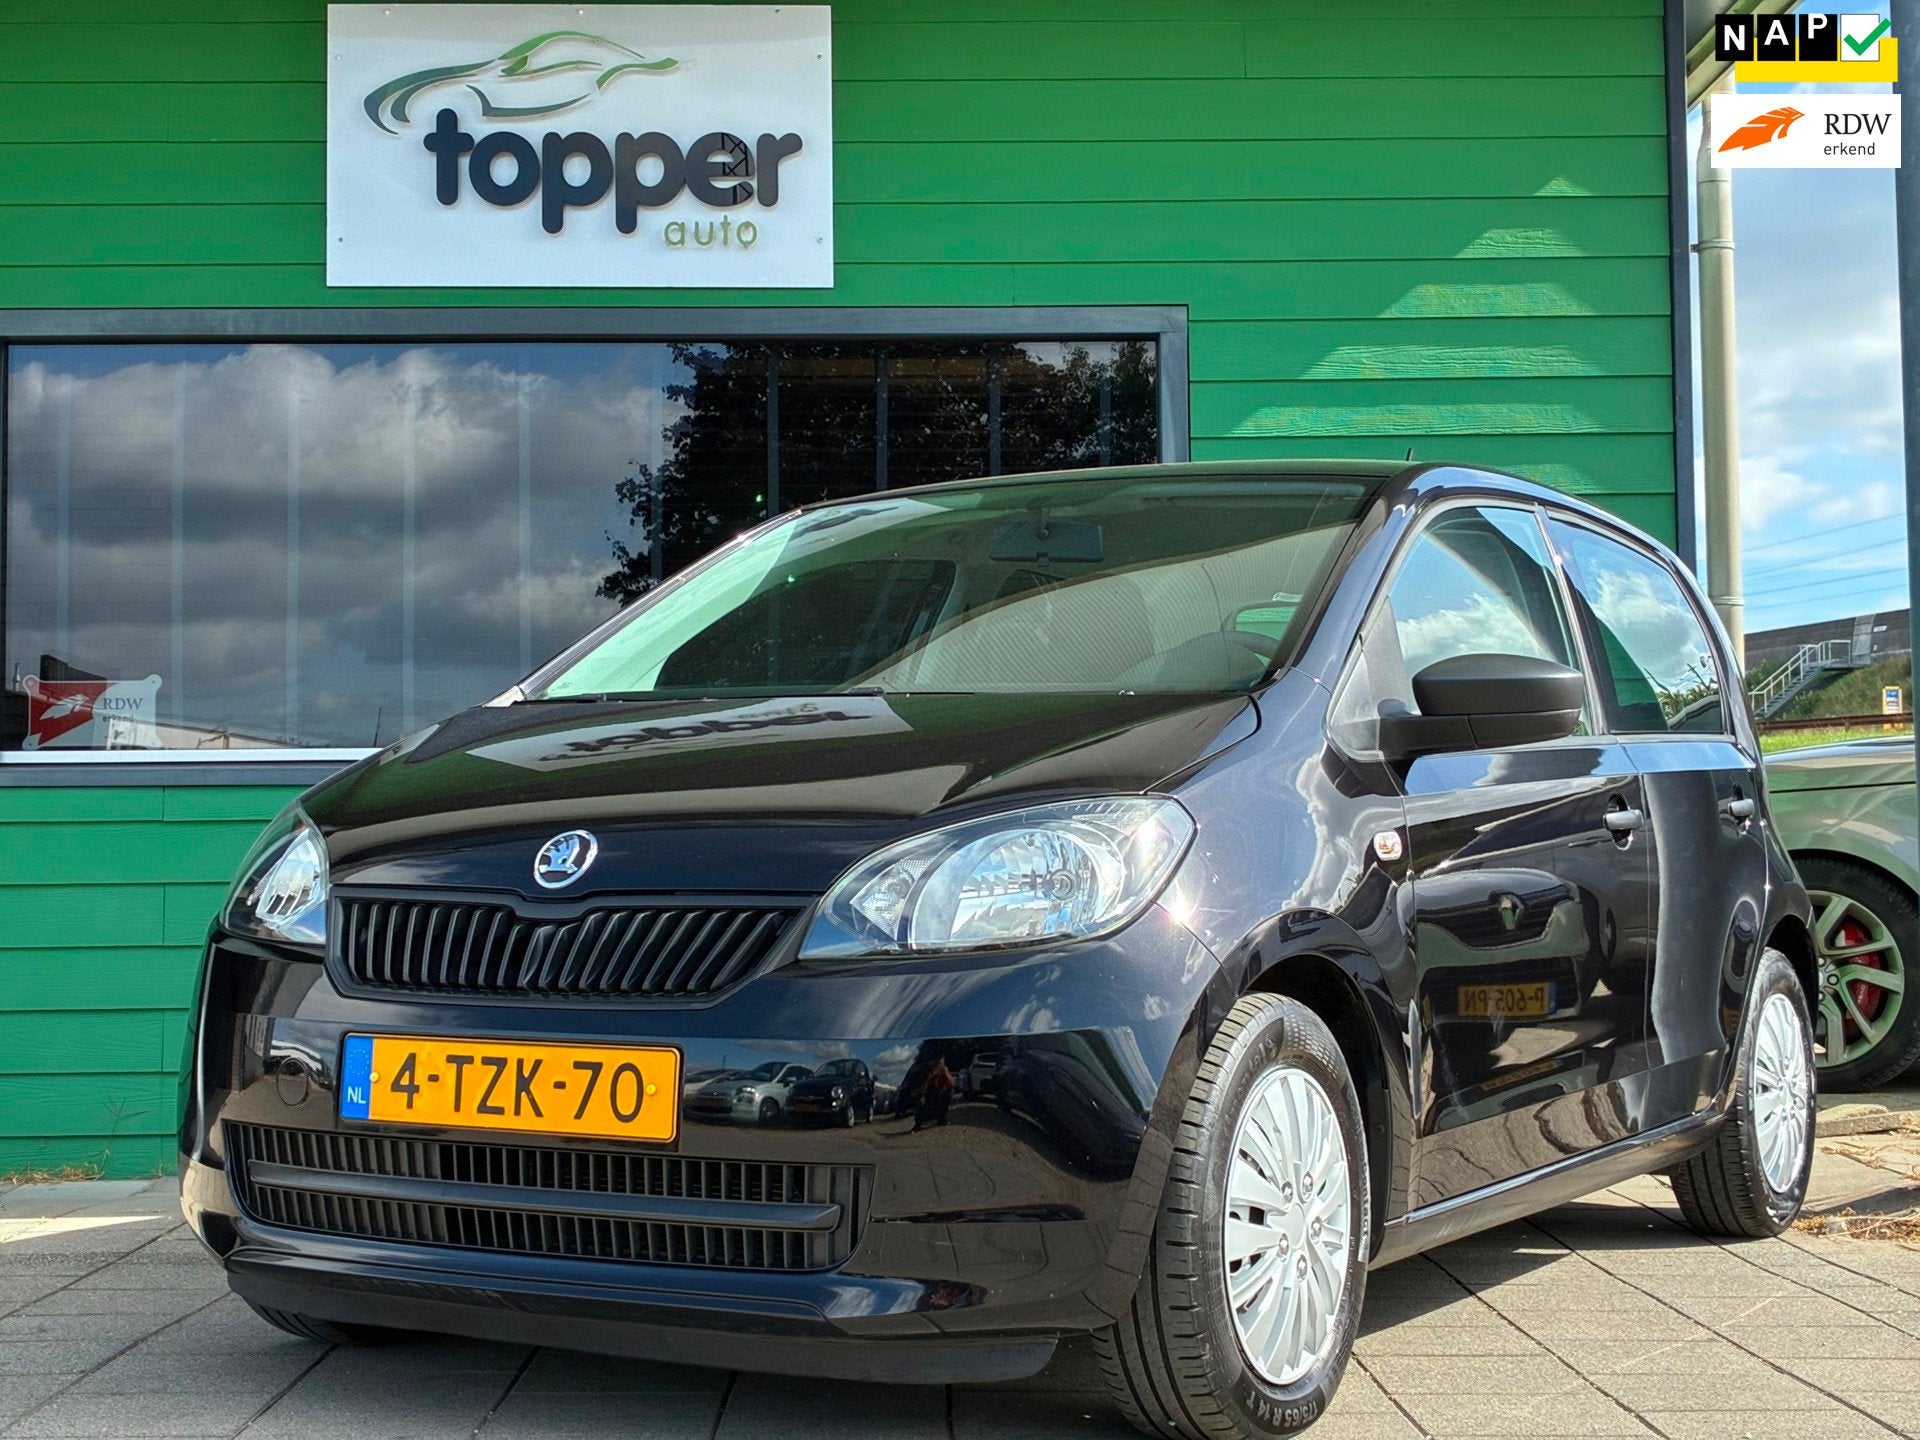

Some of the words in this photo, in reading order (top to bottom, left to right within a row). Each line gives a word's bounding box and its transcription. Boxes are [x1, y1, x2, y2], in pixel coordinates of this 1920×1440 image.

[423, 108, 803, 235] topper
[664, 215, 758, 249] auto
[102, 697, 144, 710] RDW
[347, 1086, 367, 1105] NL
[390, 1052, 645, 1124] 4-TZK-70
[1272, 1406, 1282, 1426] R
[1284, 1400, 1319, 1428] 175/65
